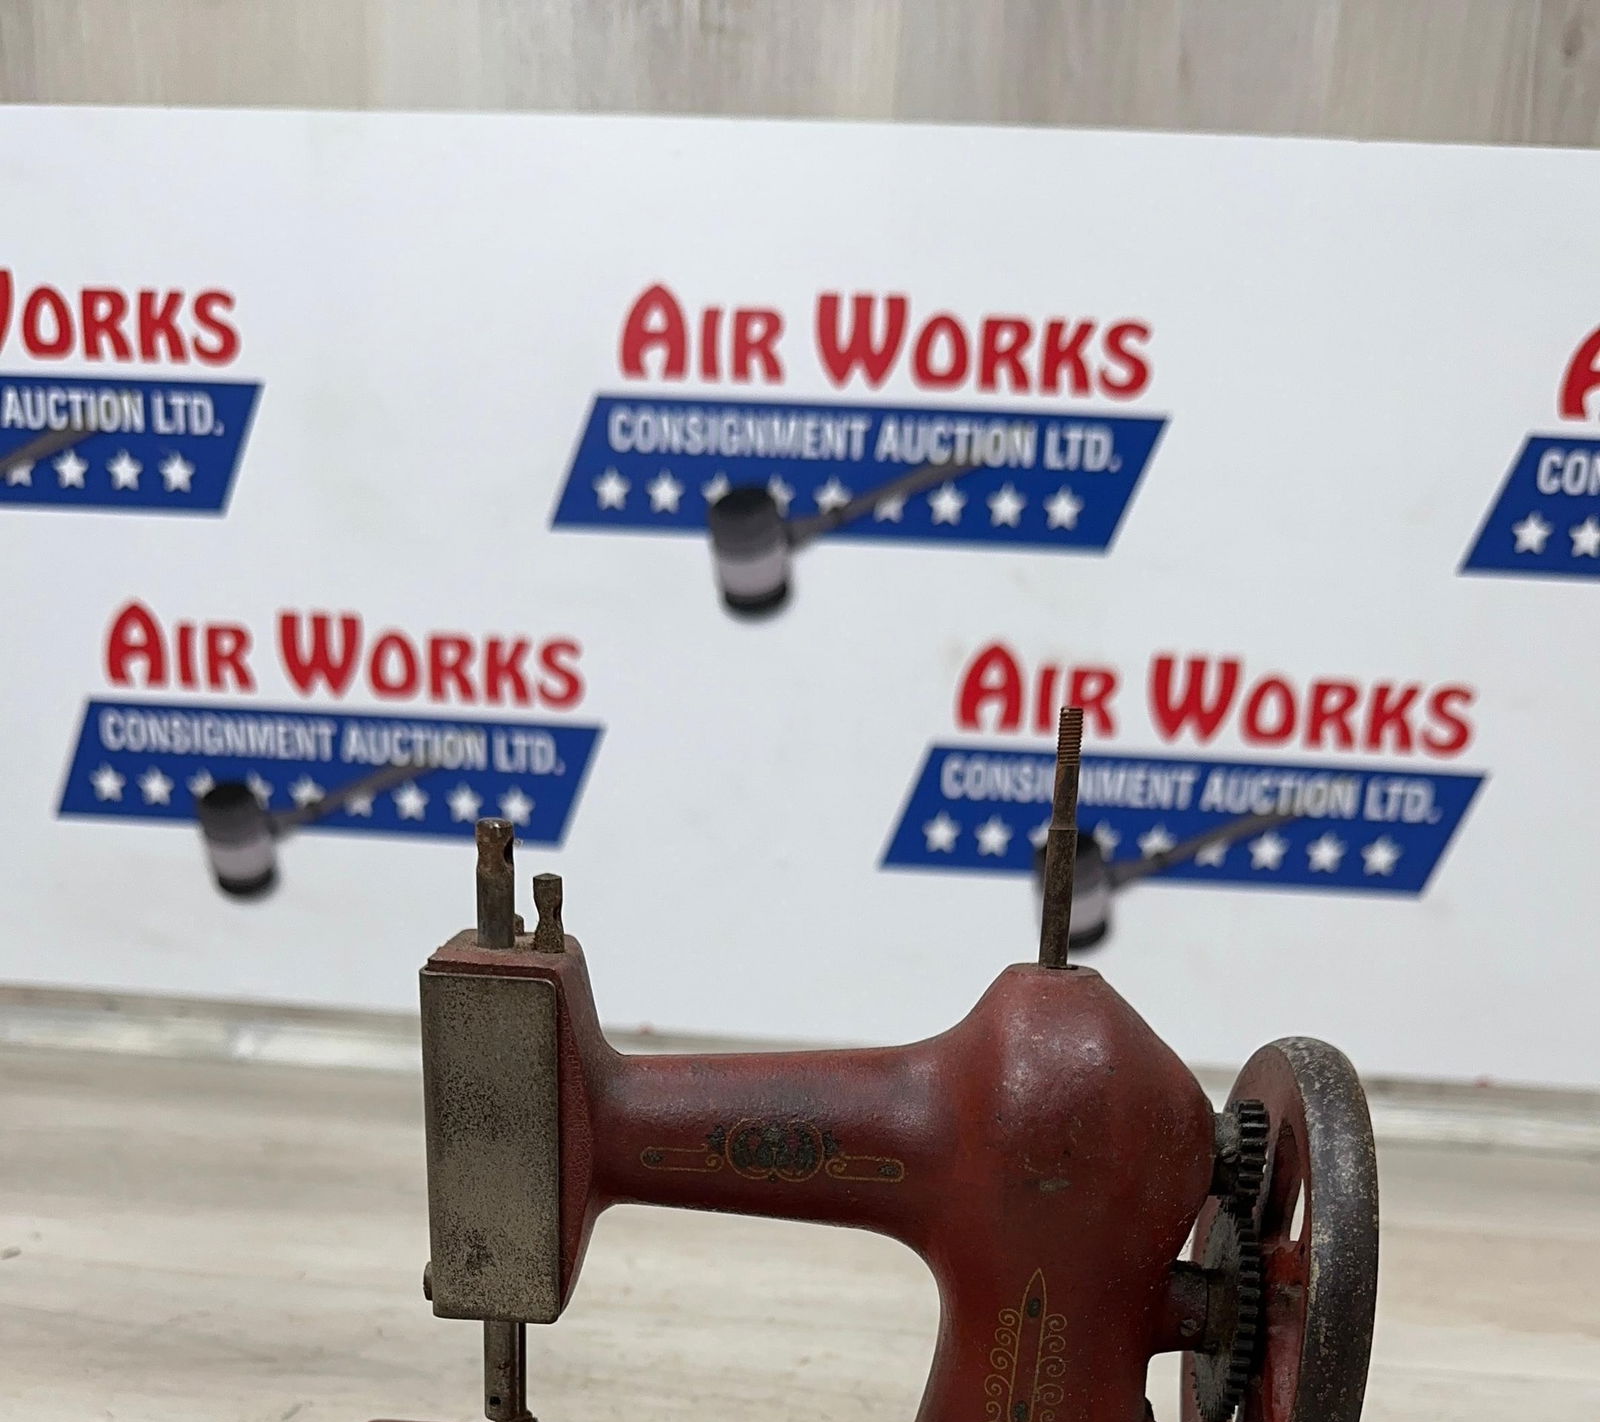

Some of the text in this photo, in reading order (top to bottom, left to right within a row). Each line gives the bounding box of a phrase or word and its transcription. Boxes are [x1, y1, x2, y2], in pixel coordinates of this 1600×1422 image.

[0, 267, 241, 366] ORKS
[618, 282, 1151, 400] AIR WORKS
[2, 386, 225, 436] AUCTION LTD.
[608, 404, 1122, 473] CONSIGNMENT AUCTION LTD.
[104, 601, 584, 710] AIR WORKS
[100, 708, 566, 776] CONSIGNMENT AUCTION LTD.
[954, 641, 1474, 759] AIR WORKS
[940, 753, 1443, 825] CONSINMENT AUCTION LTD.
